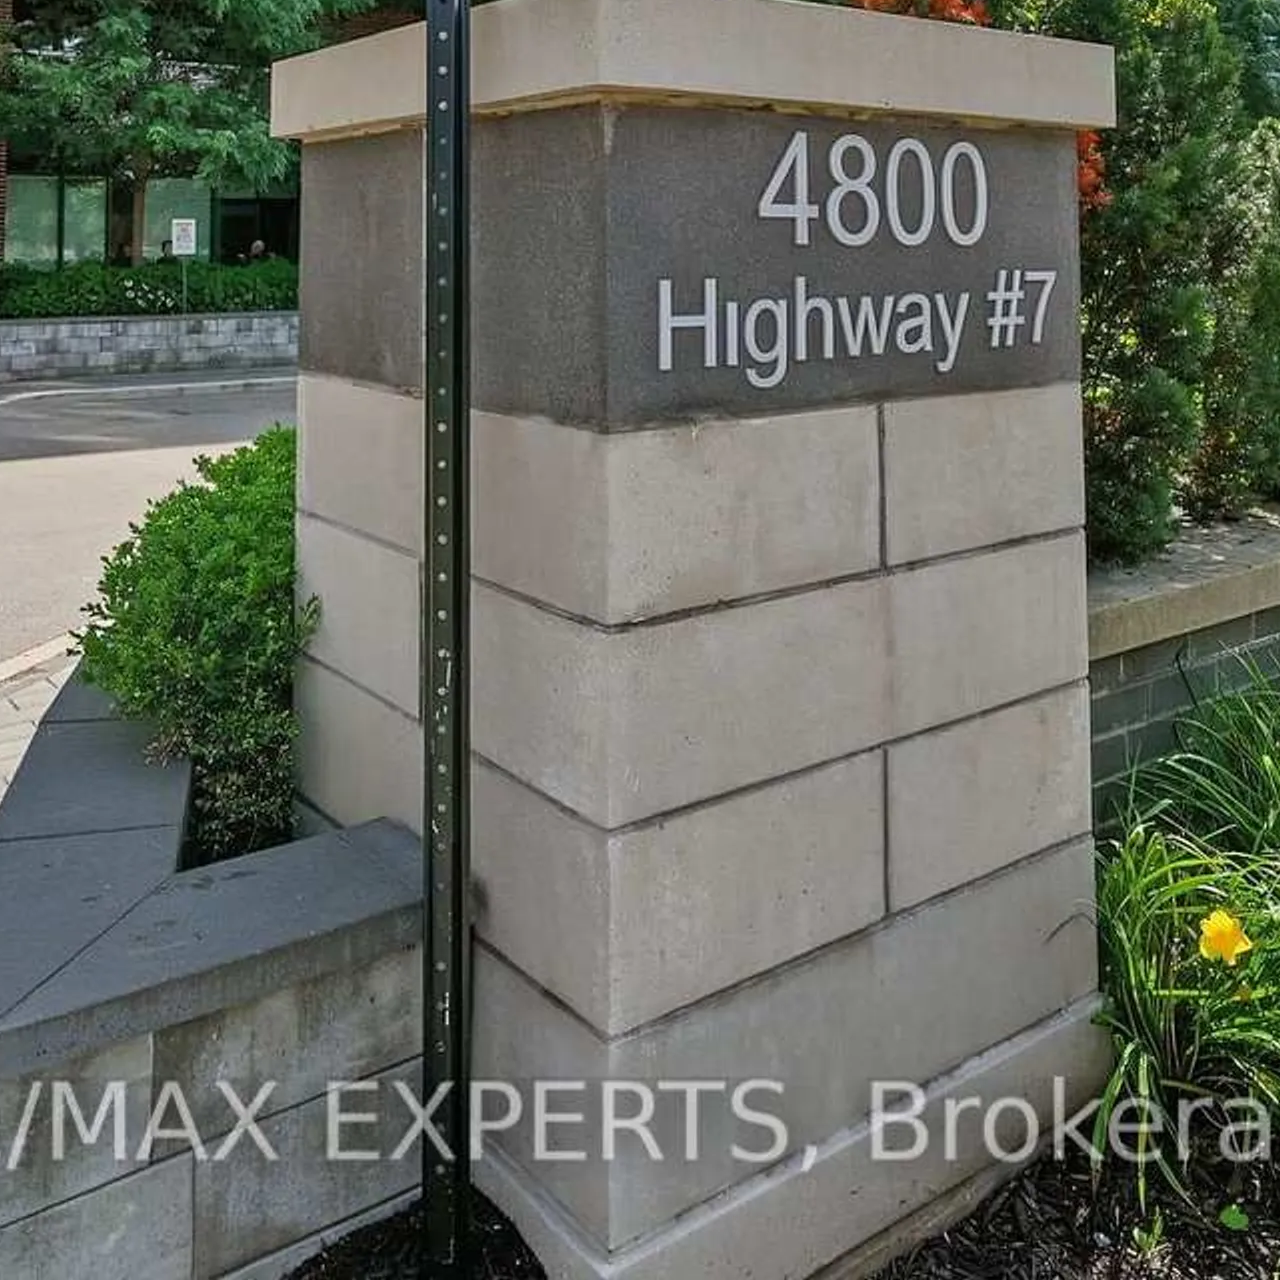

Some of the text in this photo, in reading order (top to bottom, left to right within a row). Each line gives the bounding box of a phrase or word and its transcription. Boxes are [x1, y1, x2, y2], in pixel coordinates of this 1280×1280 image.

[757, 131, 988, 247] 4800
[658, 268, 1058, 389] Highway #7
